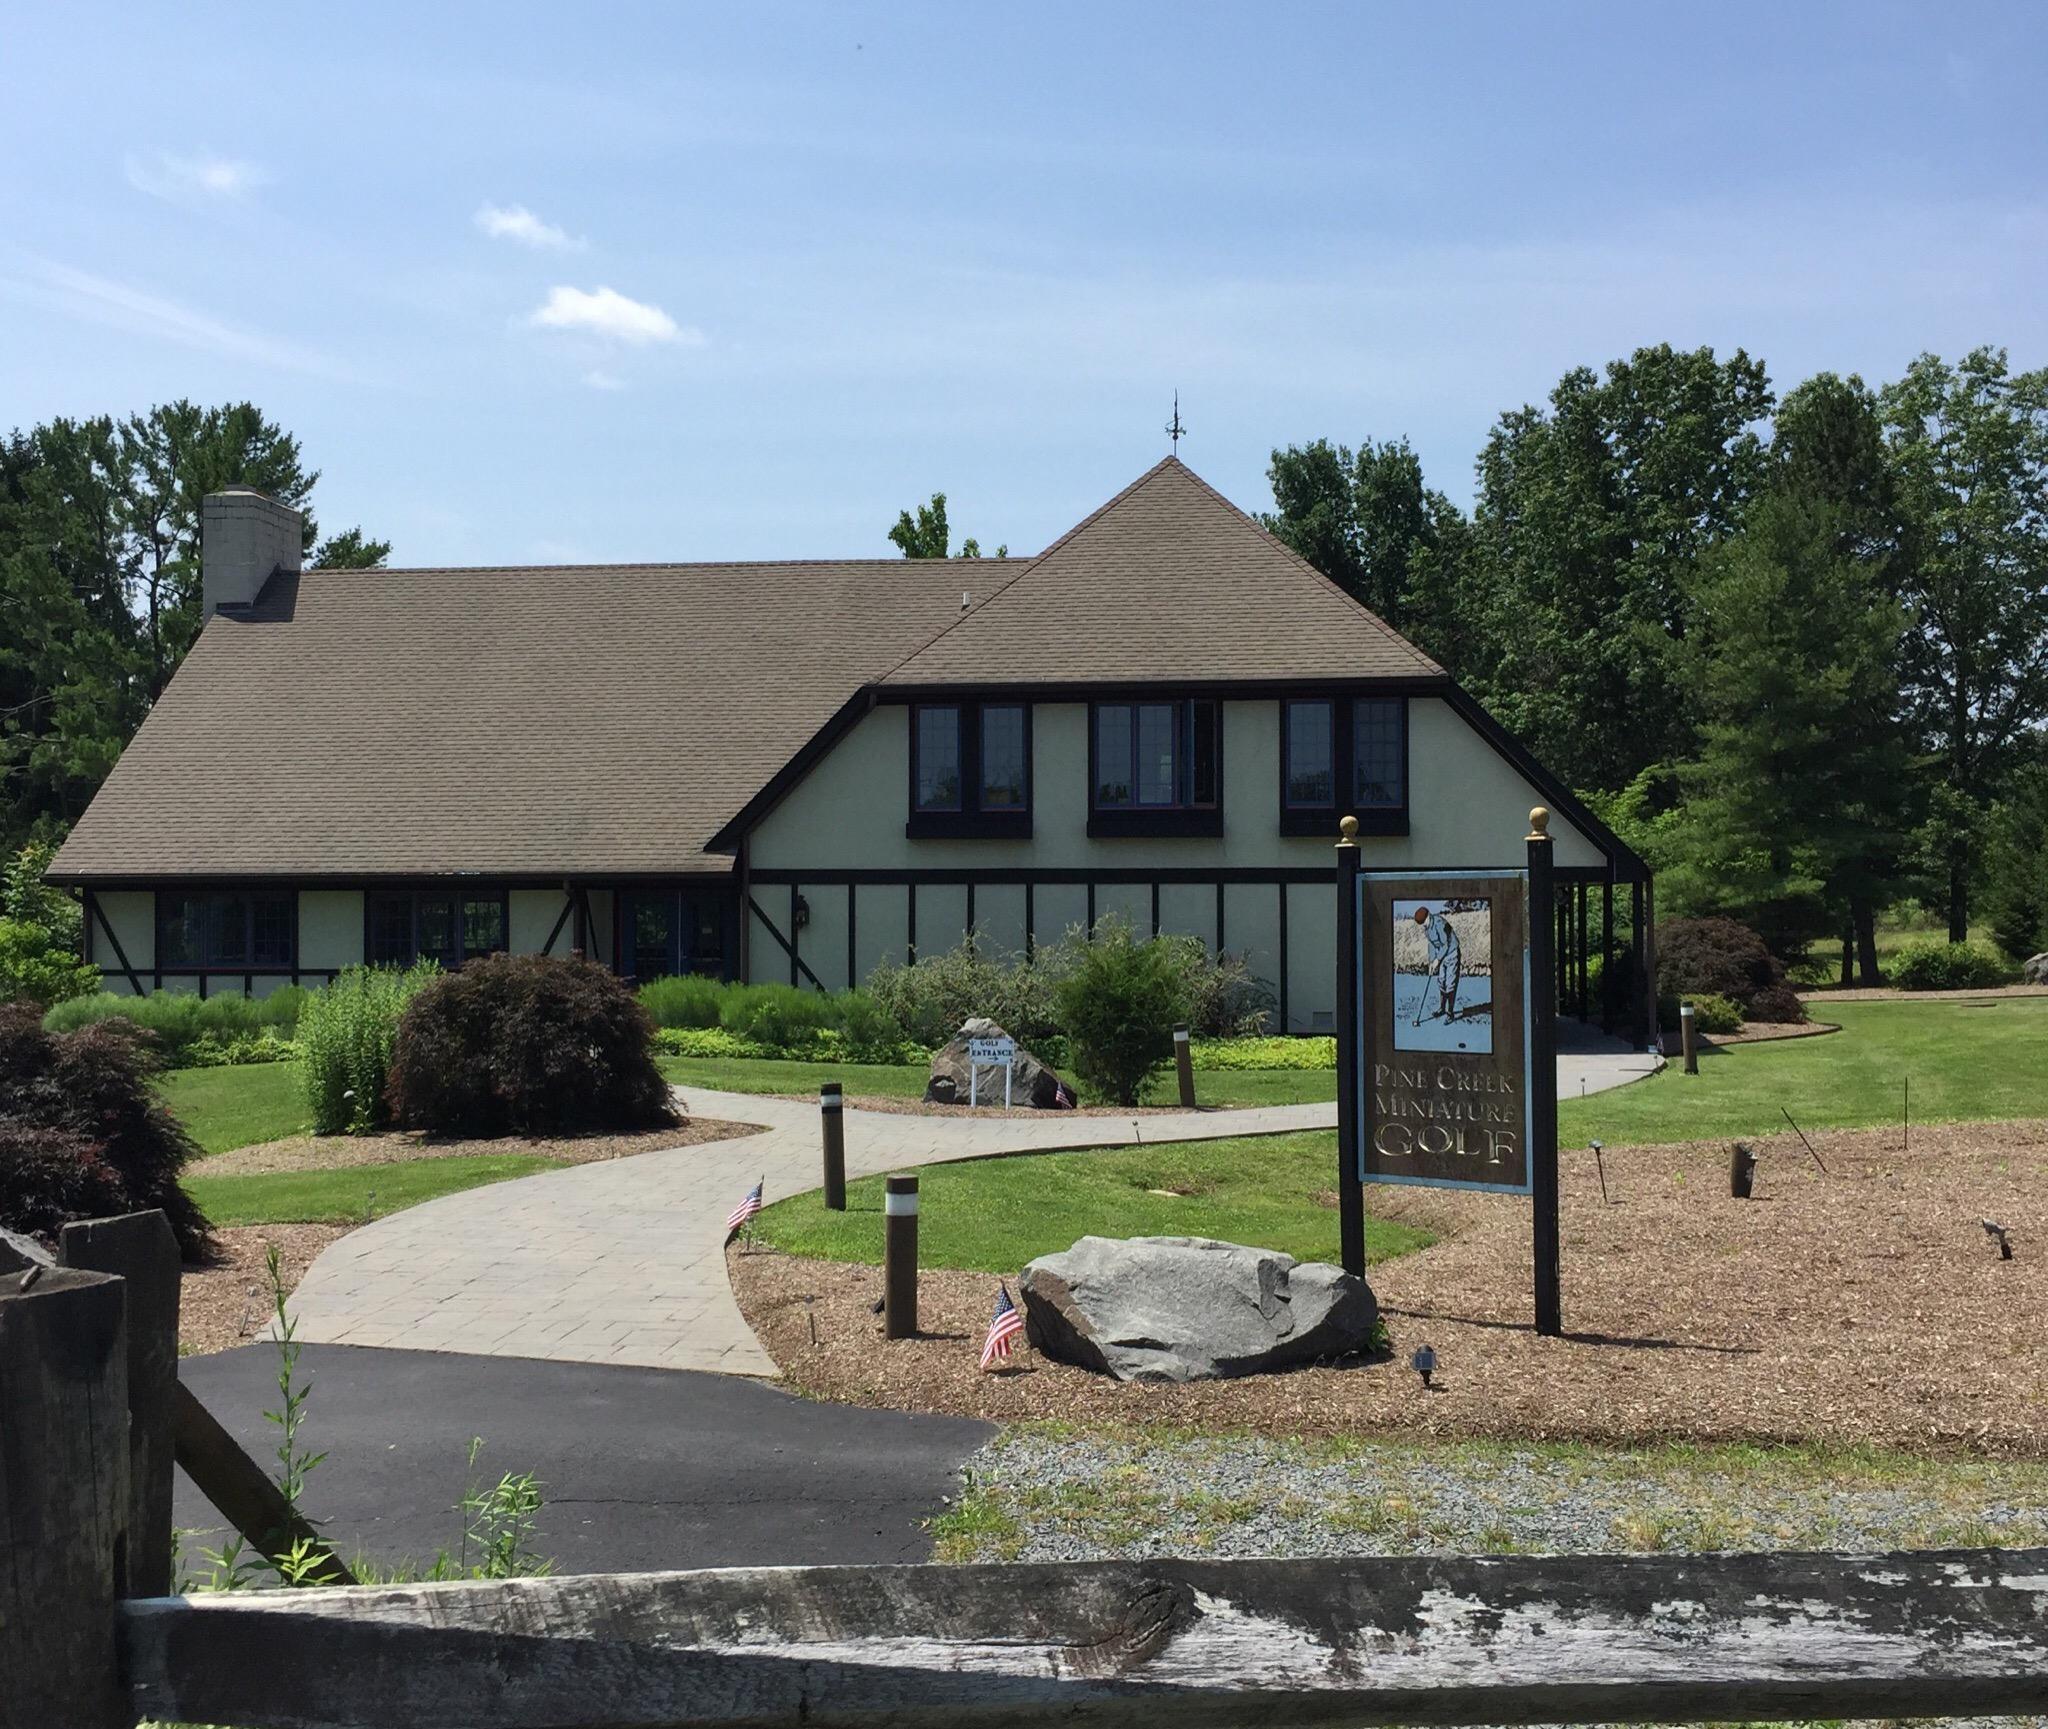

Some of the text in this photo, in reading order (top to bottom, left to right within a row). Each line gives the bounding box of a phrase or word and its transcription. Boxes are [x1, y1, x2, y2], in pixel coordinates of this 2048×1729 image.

[971, 1049, 1013, 1057] ENTRANCE
[1375, 1063, 1515, 1094] PINE CREEK
[1375, 1092, 1517, 1123] MINIATURE
[1374, 1123, 1517, 1165] GOLF
